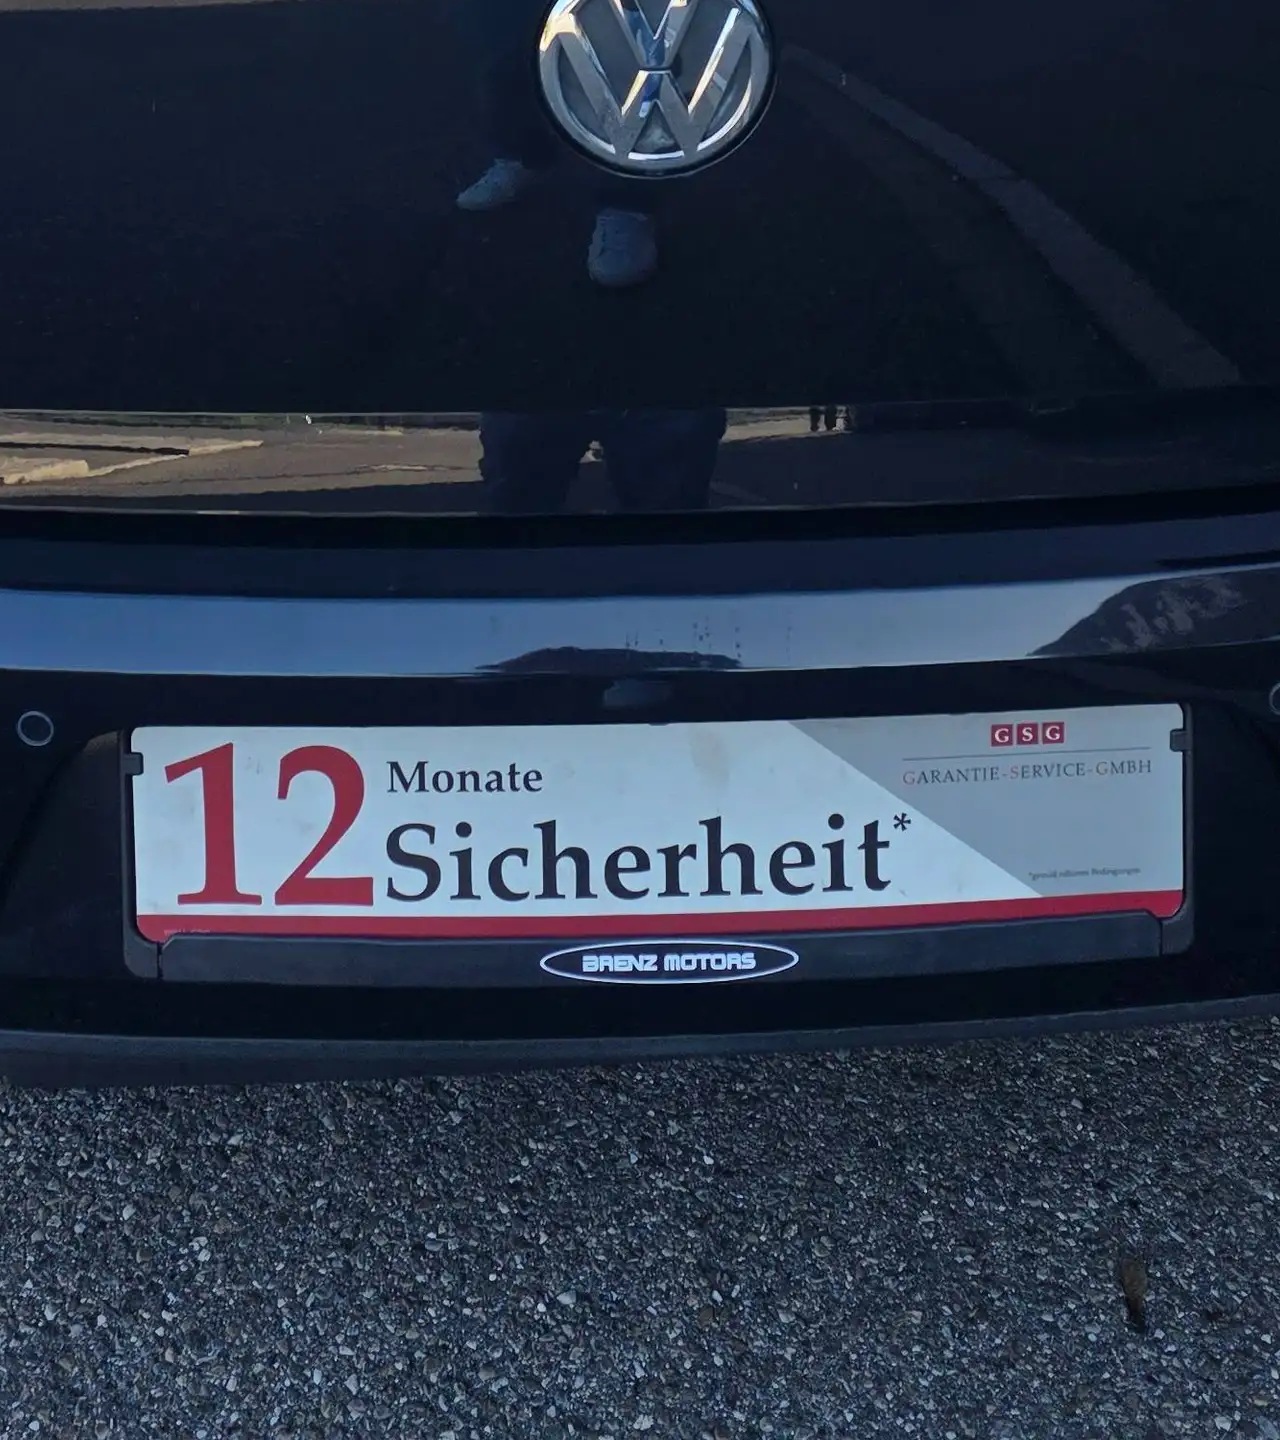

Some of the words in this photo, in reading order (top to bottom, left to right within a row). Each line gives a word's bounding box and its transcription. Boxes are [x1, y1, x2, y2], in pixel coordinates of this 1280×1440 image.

[991, 722, 1064, 746] GSG
[902, 759, 1153, 785] GARANTIE-SERVICE-GMBH
[163, 742, 374, 907] 12
[387, 760, 544, 795] Monate
[663, 952, 757, 971] MOTORS
